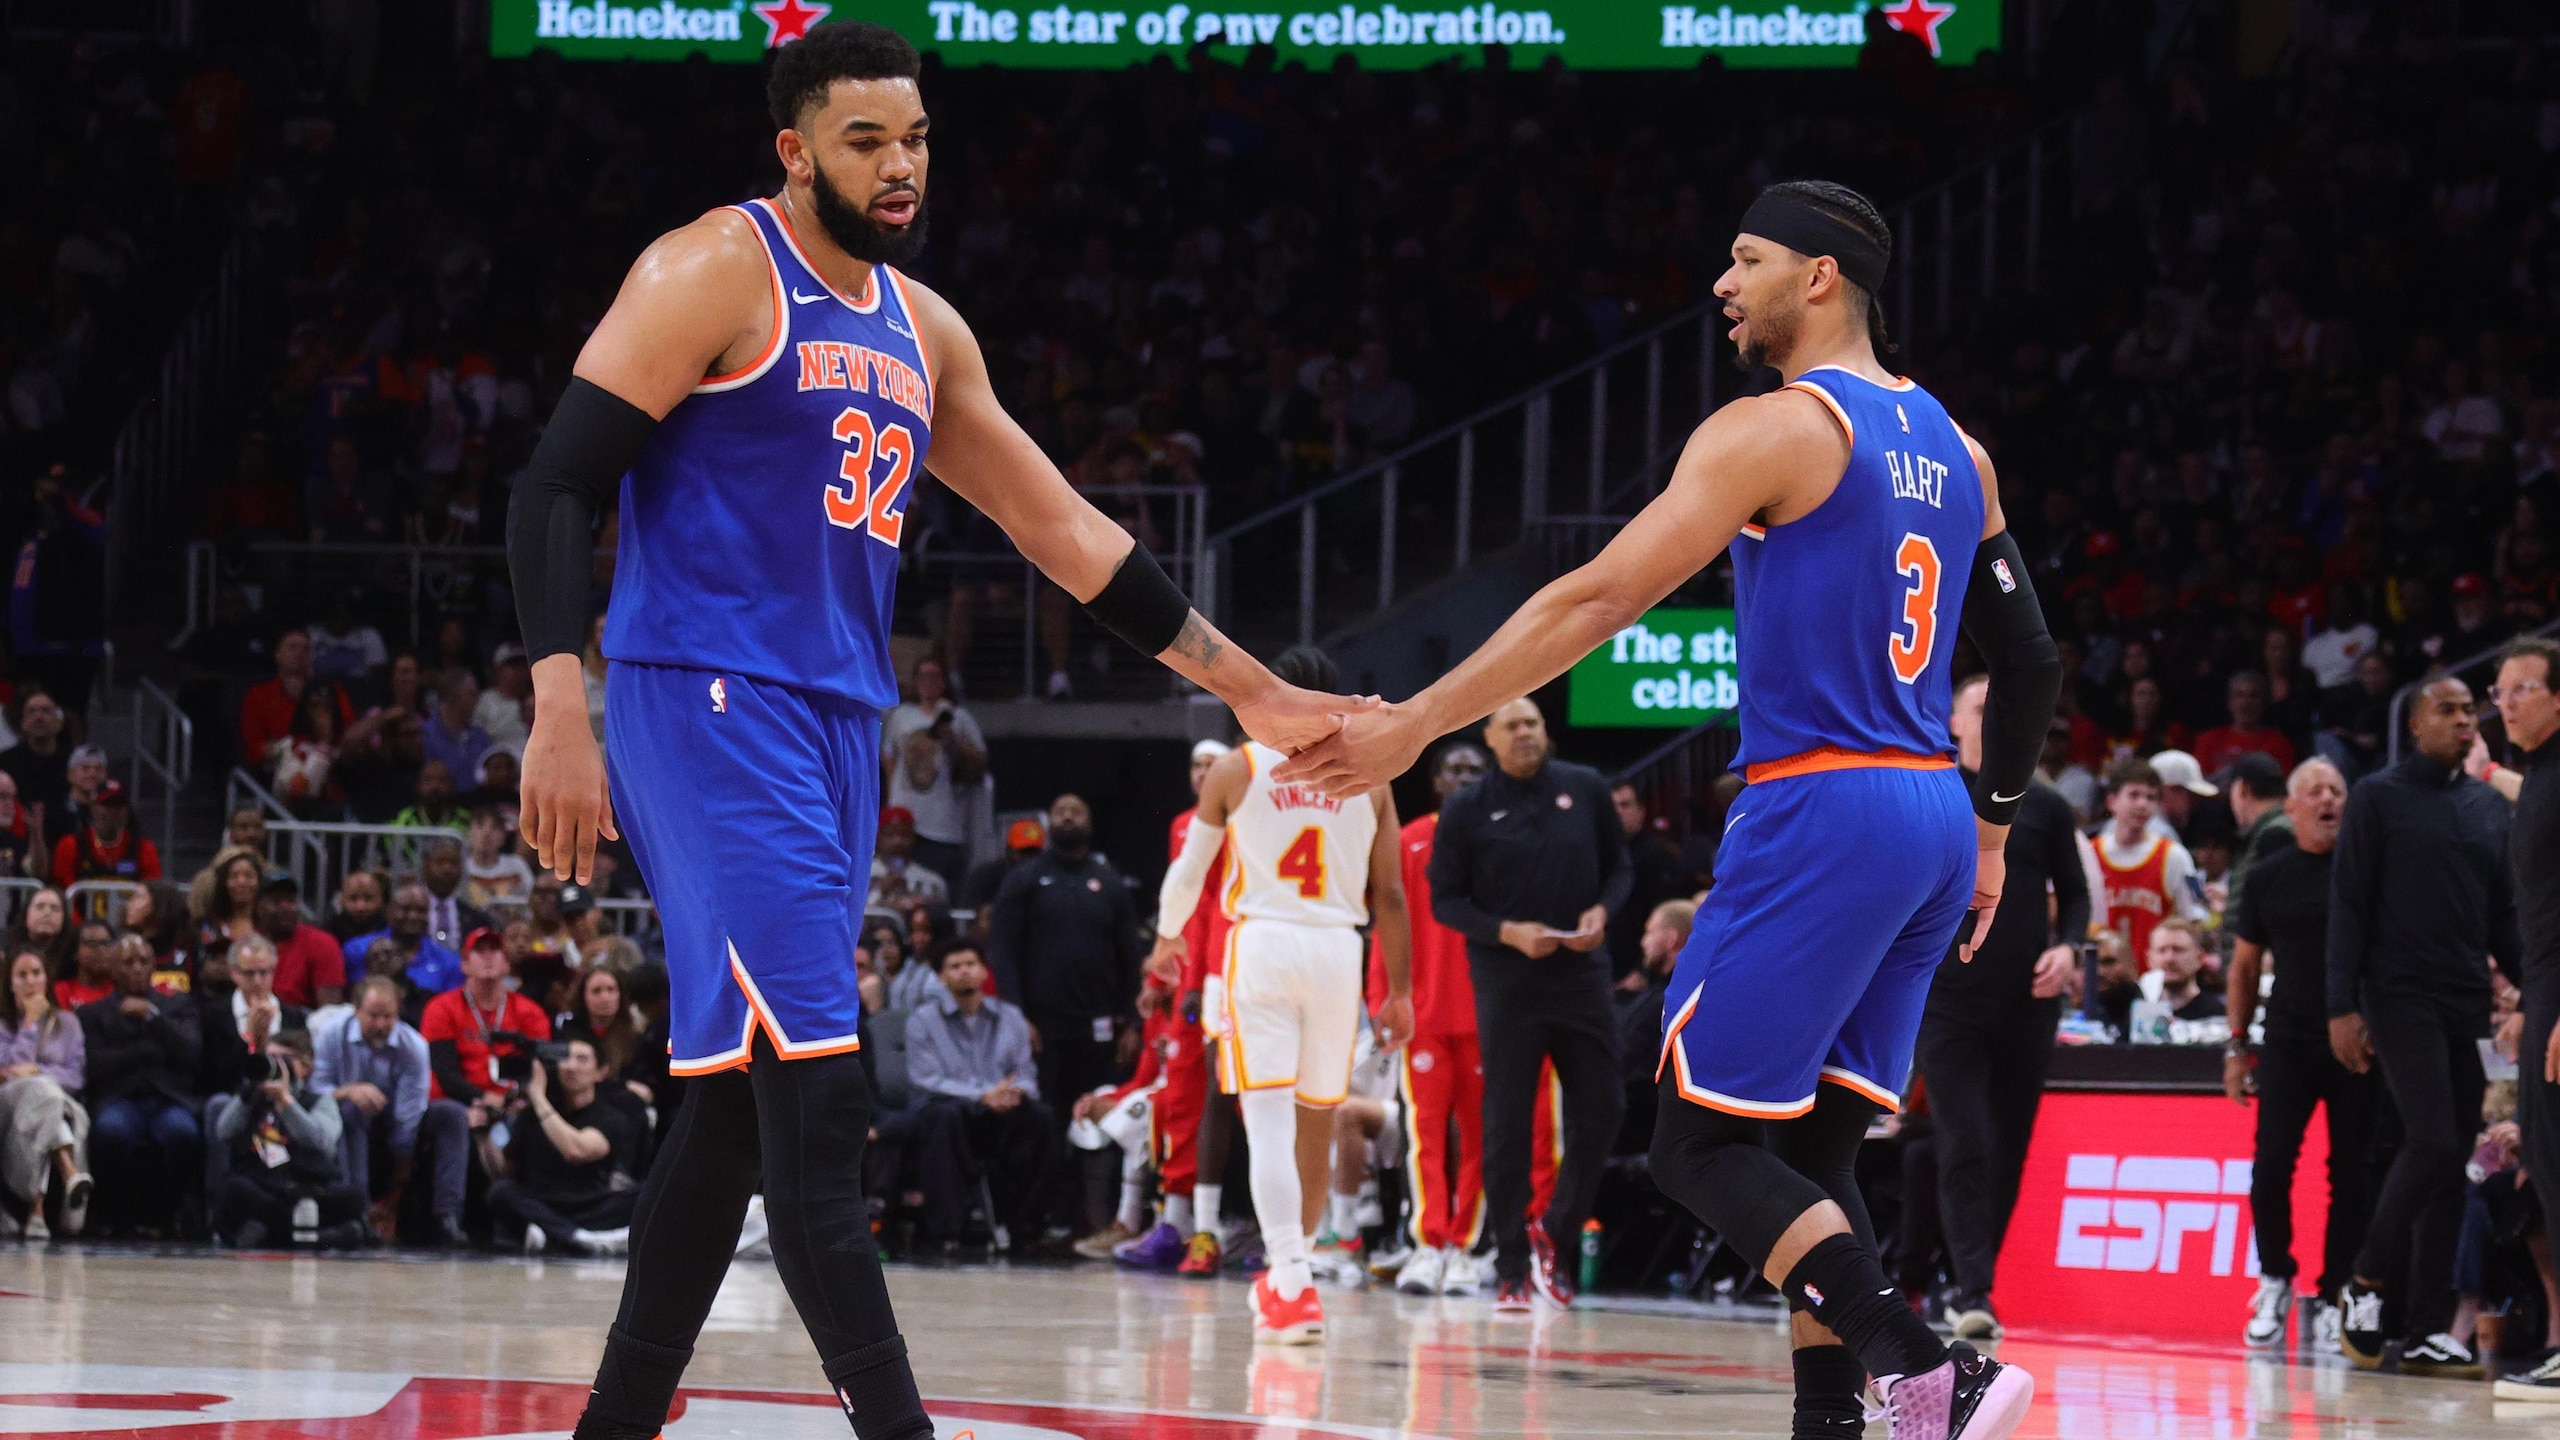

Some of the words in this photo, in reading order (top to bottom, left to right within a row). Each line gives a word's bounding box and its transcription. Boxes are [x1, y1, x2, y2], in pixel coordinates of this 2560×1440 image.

[536, 0, 743, 41] Heineken
[928, 1, 1018, 42] The
[1028, 4, 1127, 44] star
[1135, 3, 1190, 45] of
[1289, 3, 1566, 46] celebration.
[1660, 4, 1867, 47] Heineken
[823, 406, 914, 549] 32
[1885, 450, 1948, 510] HART
[1888, 531, 1942, 686] 3
[1611, 624, 1683, 664] The
[1689, 626, 1737, 664] st
[1277, 825, 1327, 900] 4
[2055, 1153, 2262, 1279] ESPN
